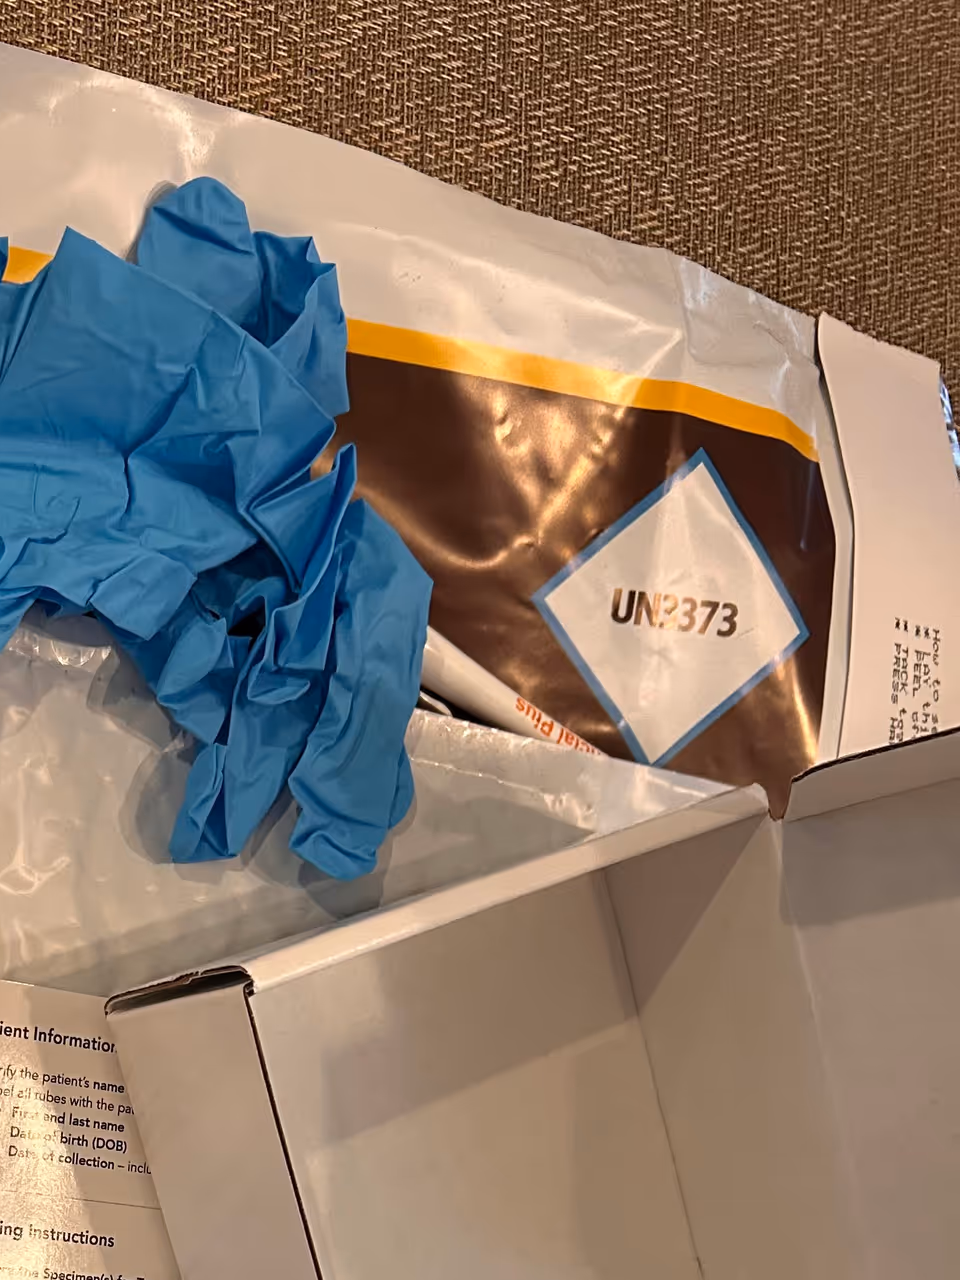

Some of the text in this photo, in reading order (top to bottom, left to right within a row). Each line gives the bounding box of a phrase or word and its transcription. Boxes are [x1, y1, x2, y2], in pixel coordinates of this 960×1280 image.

[19, 1066, 39, 1081] the
[92, 1080, 125, 1094] name
[69, 1094, 115, 1112] with the
[92, 1119, 125, 1133] name
[59, 1130, 127, 1155] birth (DOB)
[57, 1151, 115, 1170] collection
